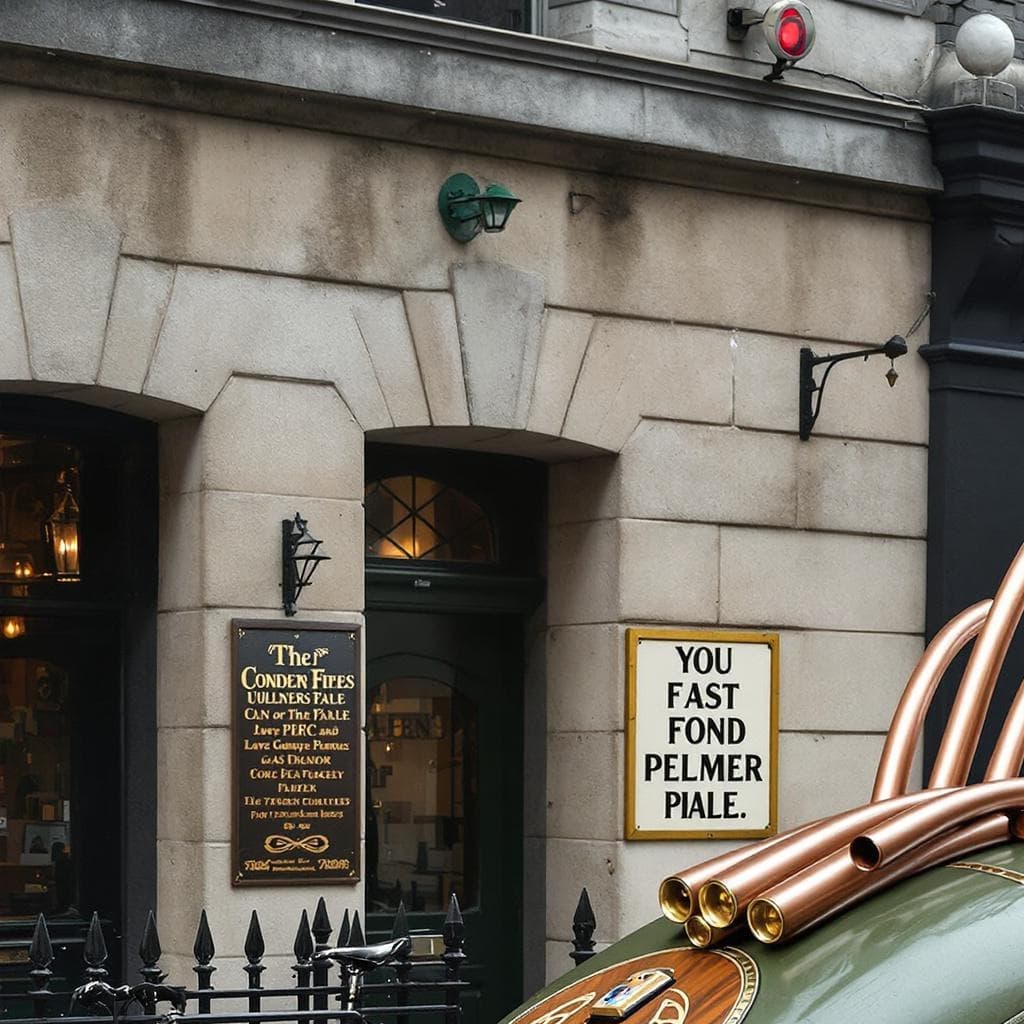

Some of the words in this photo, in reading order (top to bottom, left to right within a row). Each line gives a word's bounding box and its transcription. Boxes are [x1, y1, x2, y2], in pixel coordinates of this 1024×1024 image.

[675, 646, 732, 674] YOU
[667, 682, 740, 709] FAST
[668, 716, 746, 745] FOND
[644, 753, 763, 782] PELMER
[664, 791, 747, 819] PIALE.
